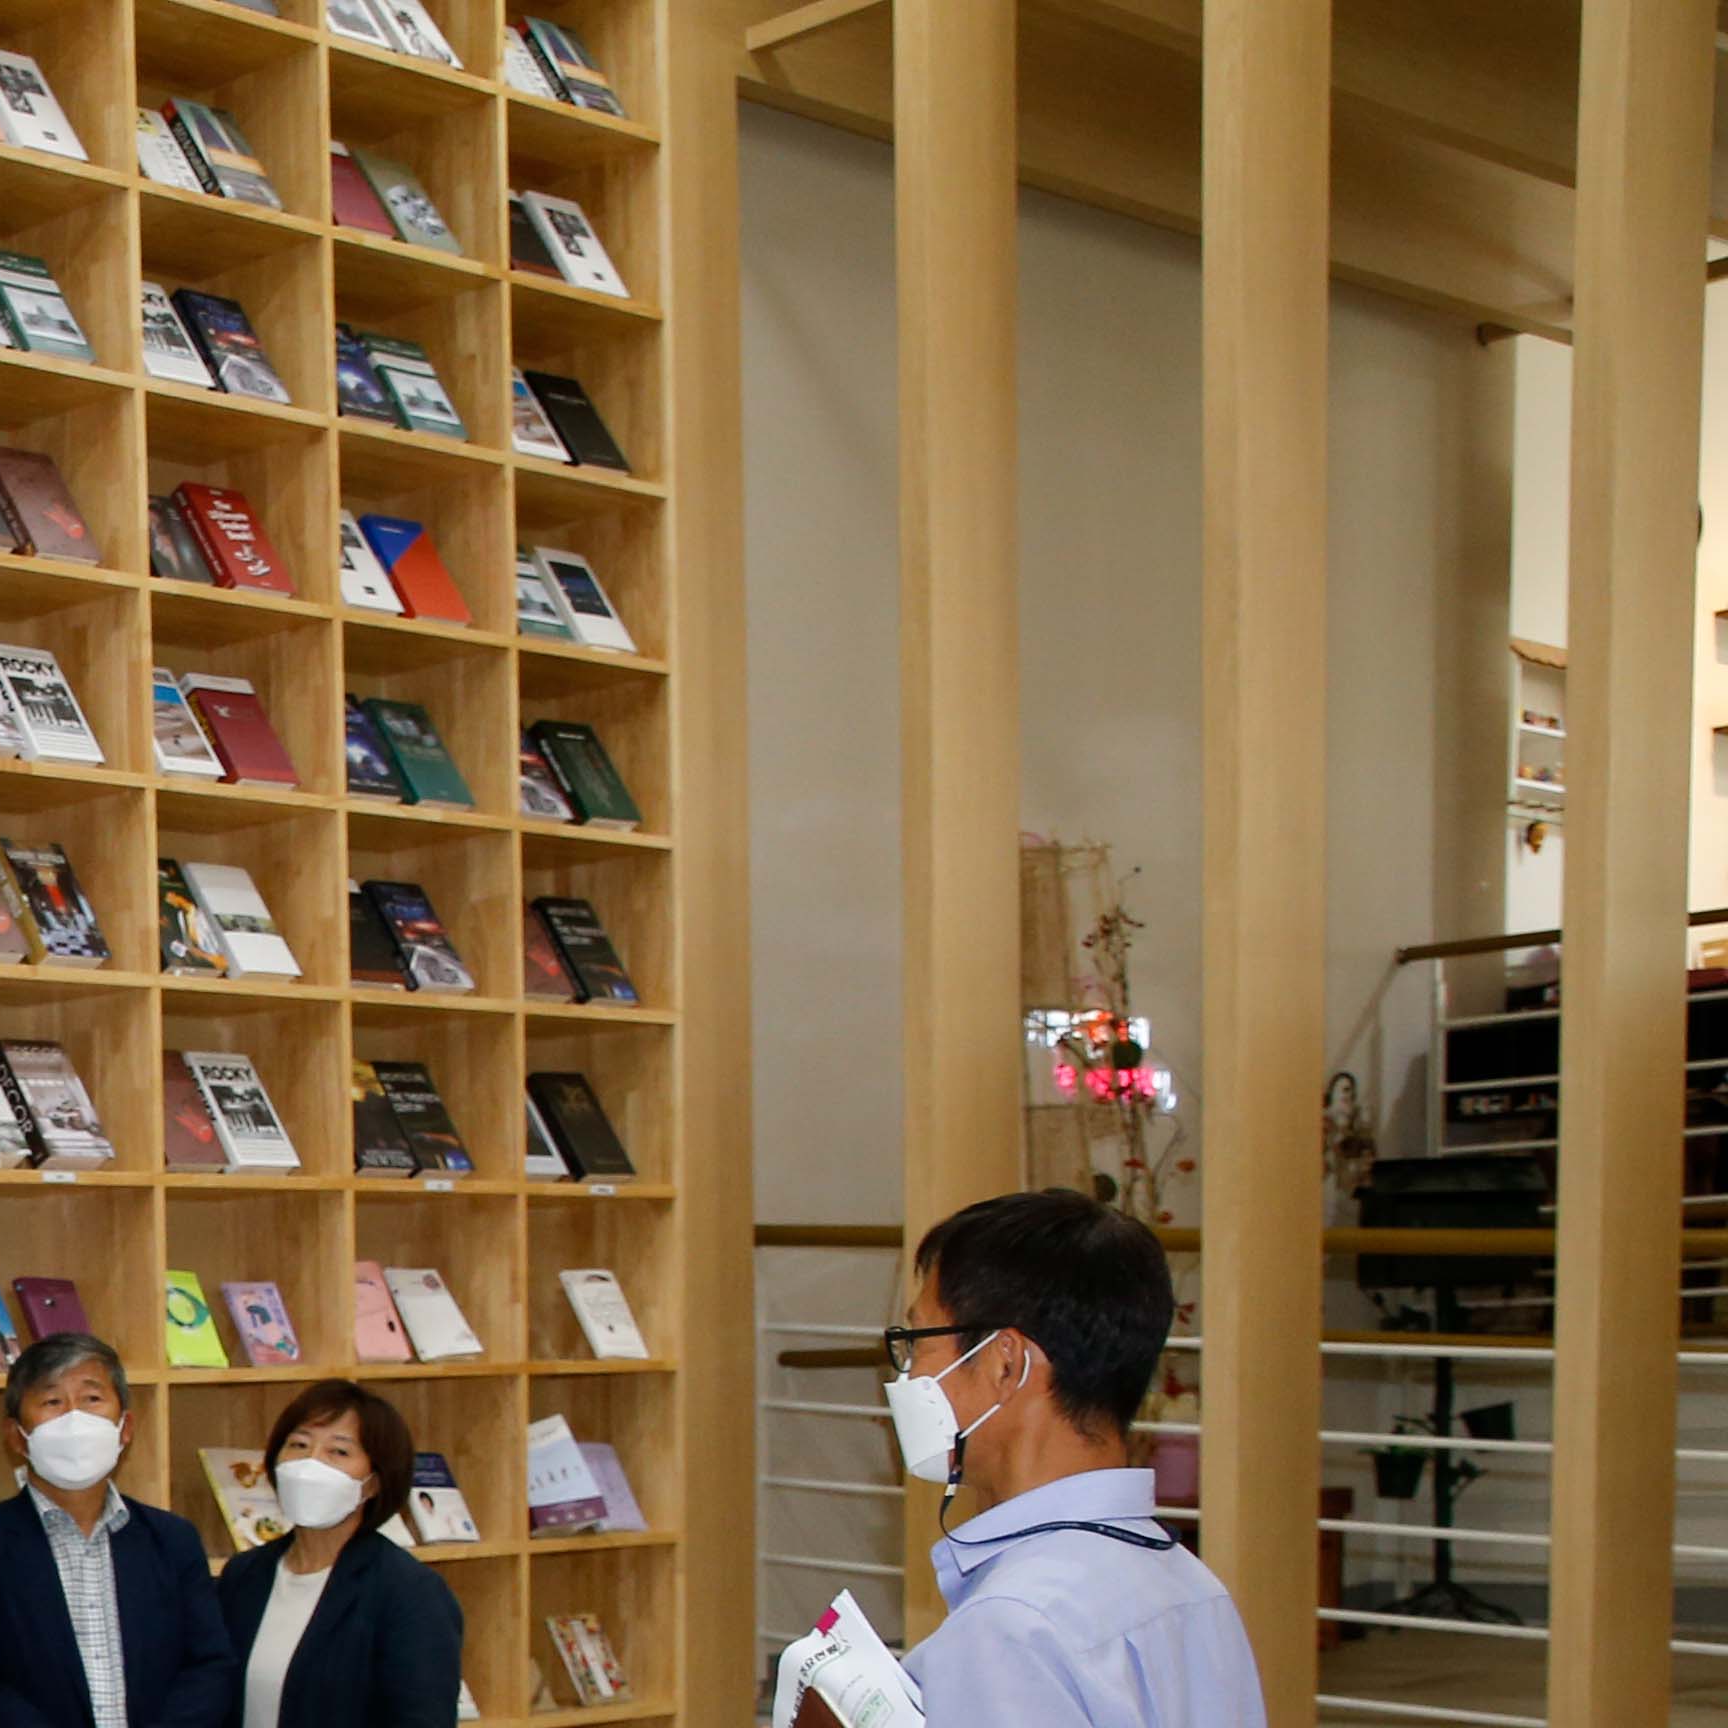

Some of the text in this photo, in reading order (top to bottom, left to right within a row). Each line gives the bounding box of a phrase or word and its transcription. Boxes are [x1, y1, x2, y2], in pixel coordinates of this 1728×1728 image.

[0, 656, 55, 677] ROCKY
[200, 1063, 252, 1083] ROCKY
[4, 1064, 42, 1134] DECOR
